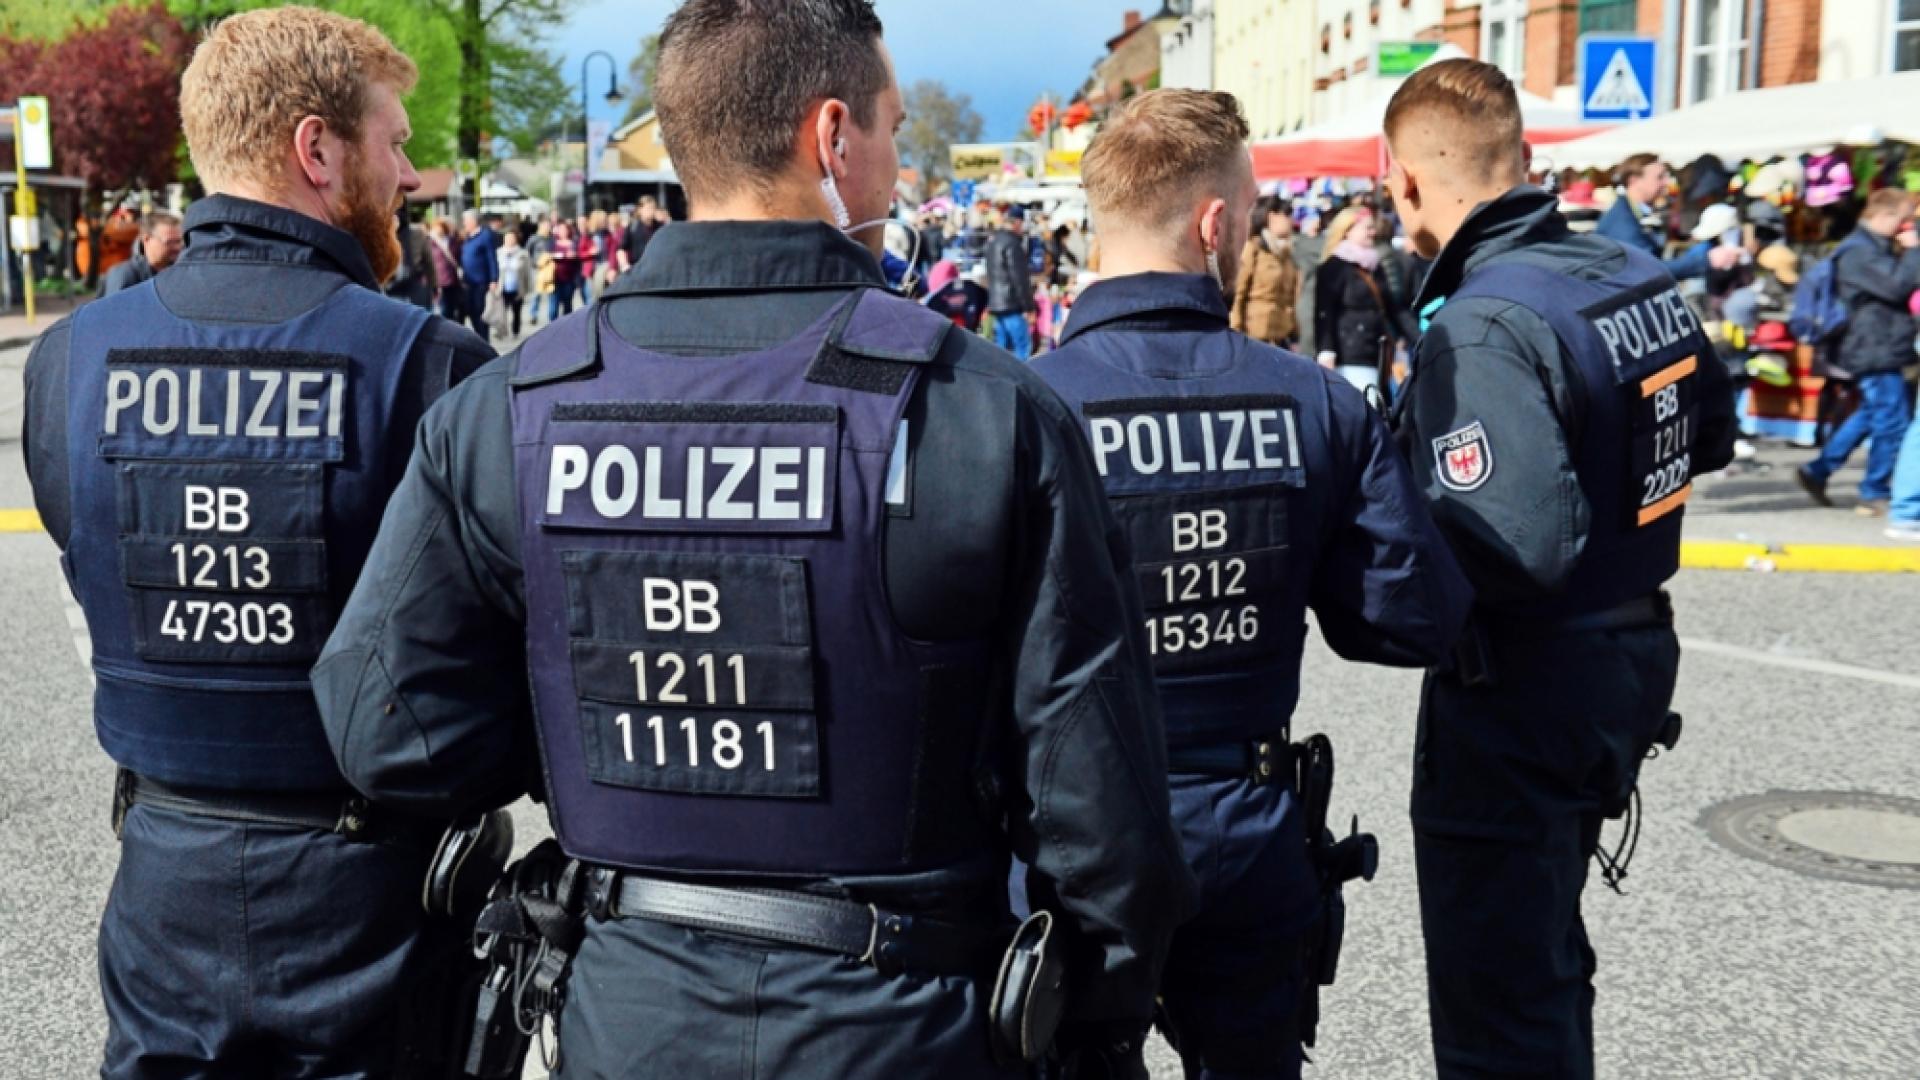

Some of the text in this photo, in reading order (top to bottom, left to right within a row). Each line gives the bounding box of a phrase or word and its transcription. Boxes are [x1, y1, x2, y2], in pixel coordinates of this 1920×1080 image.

[1593, 287, 1698, 366] POLIZEI
[105, 368, 344, 436] POLIZEI
[1655, 384, 1678, 423] BB
[1090, 408, 1301, 476] POLIZEI
[1655, 416, 1688, 463] 1211
[546, 444, 827, 520] POLIZEI
[184, 485, 249, 532] BB
[1172, 509, 1228, 552] BB
[171, 543, 271, 589] 1213
[1161, 557, 1247, 603] 1212
[160, 599, 294, 645] 47303
[643, 577, 721, 633] BB
[1144, 605, 1259, 655] 15346
[629, 650, 746, 706] 1211
[615, 713, 775, 771] 11181
